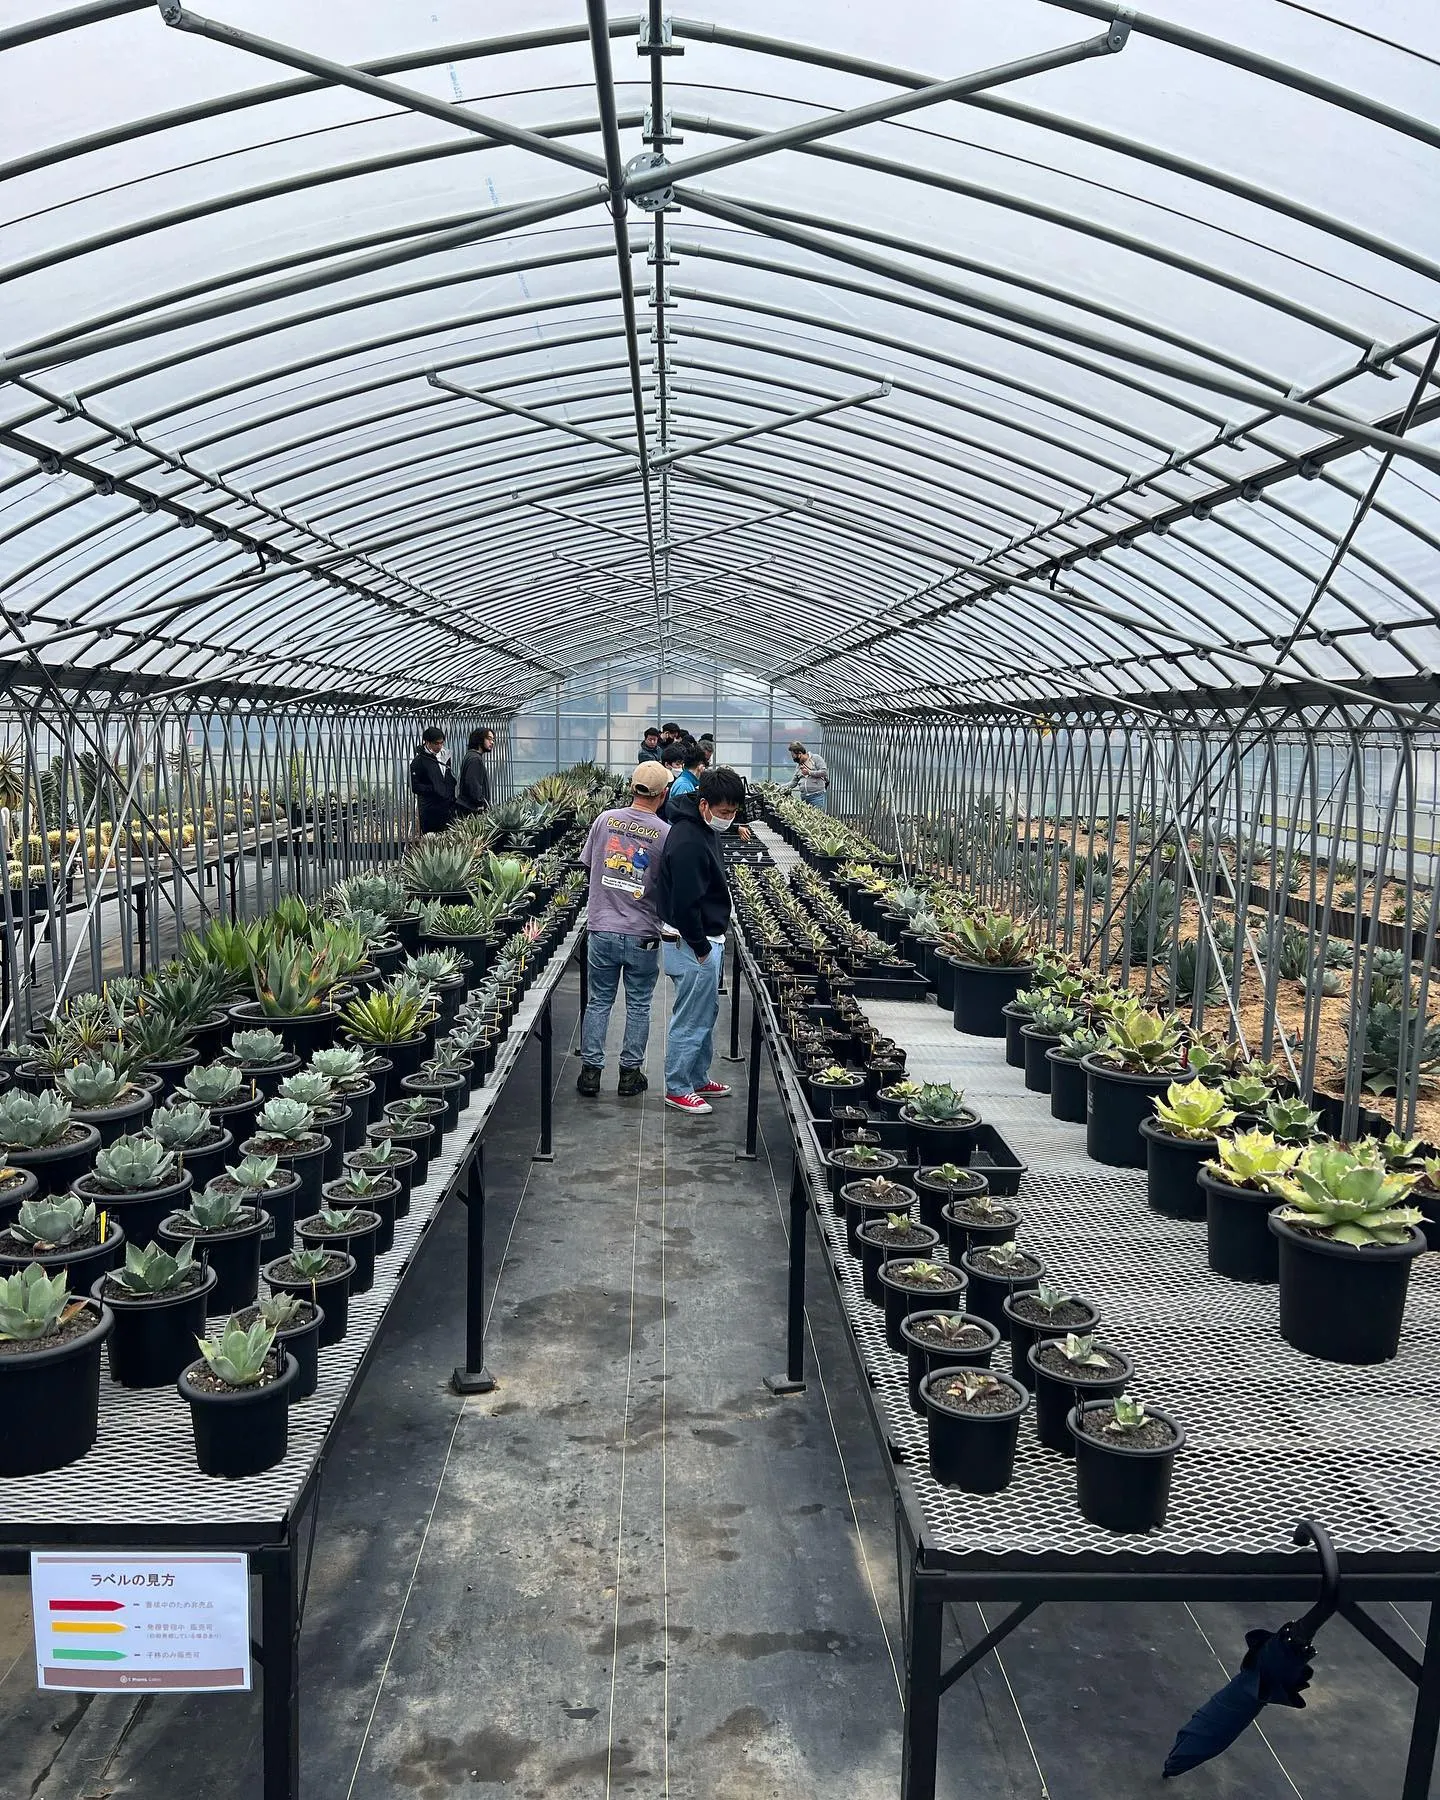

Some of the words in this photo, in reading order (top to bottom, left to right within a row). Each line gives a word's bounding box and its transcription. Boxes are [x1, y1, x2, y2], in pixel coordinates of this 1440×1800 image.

[606, 817, 626, 830] Ben
[628, 821, 659, 839] Davis
[91, 1573, 176, 1587] ラベルの見方
